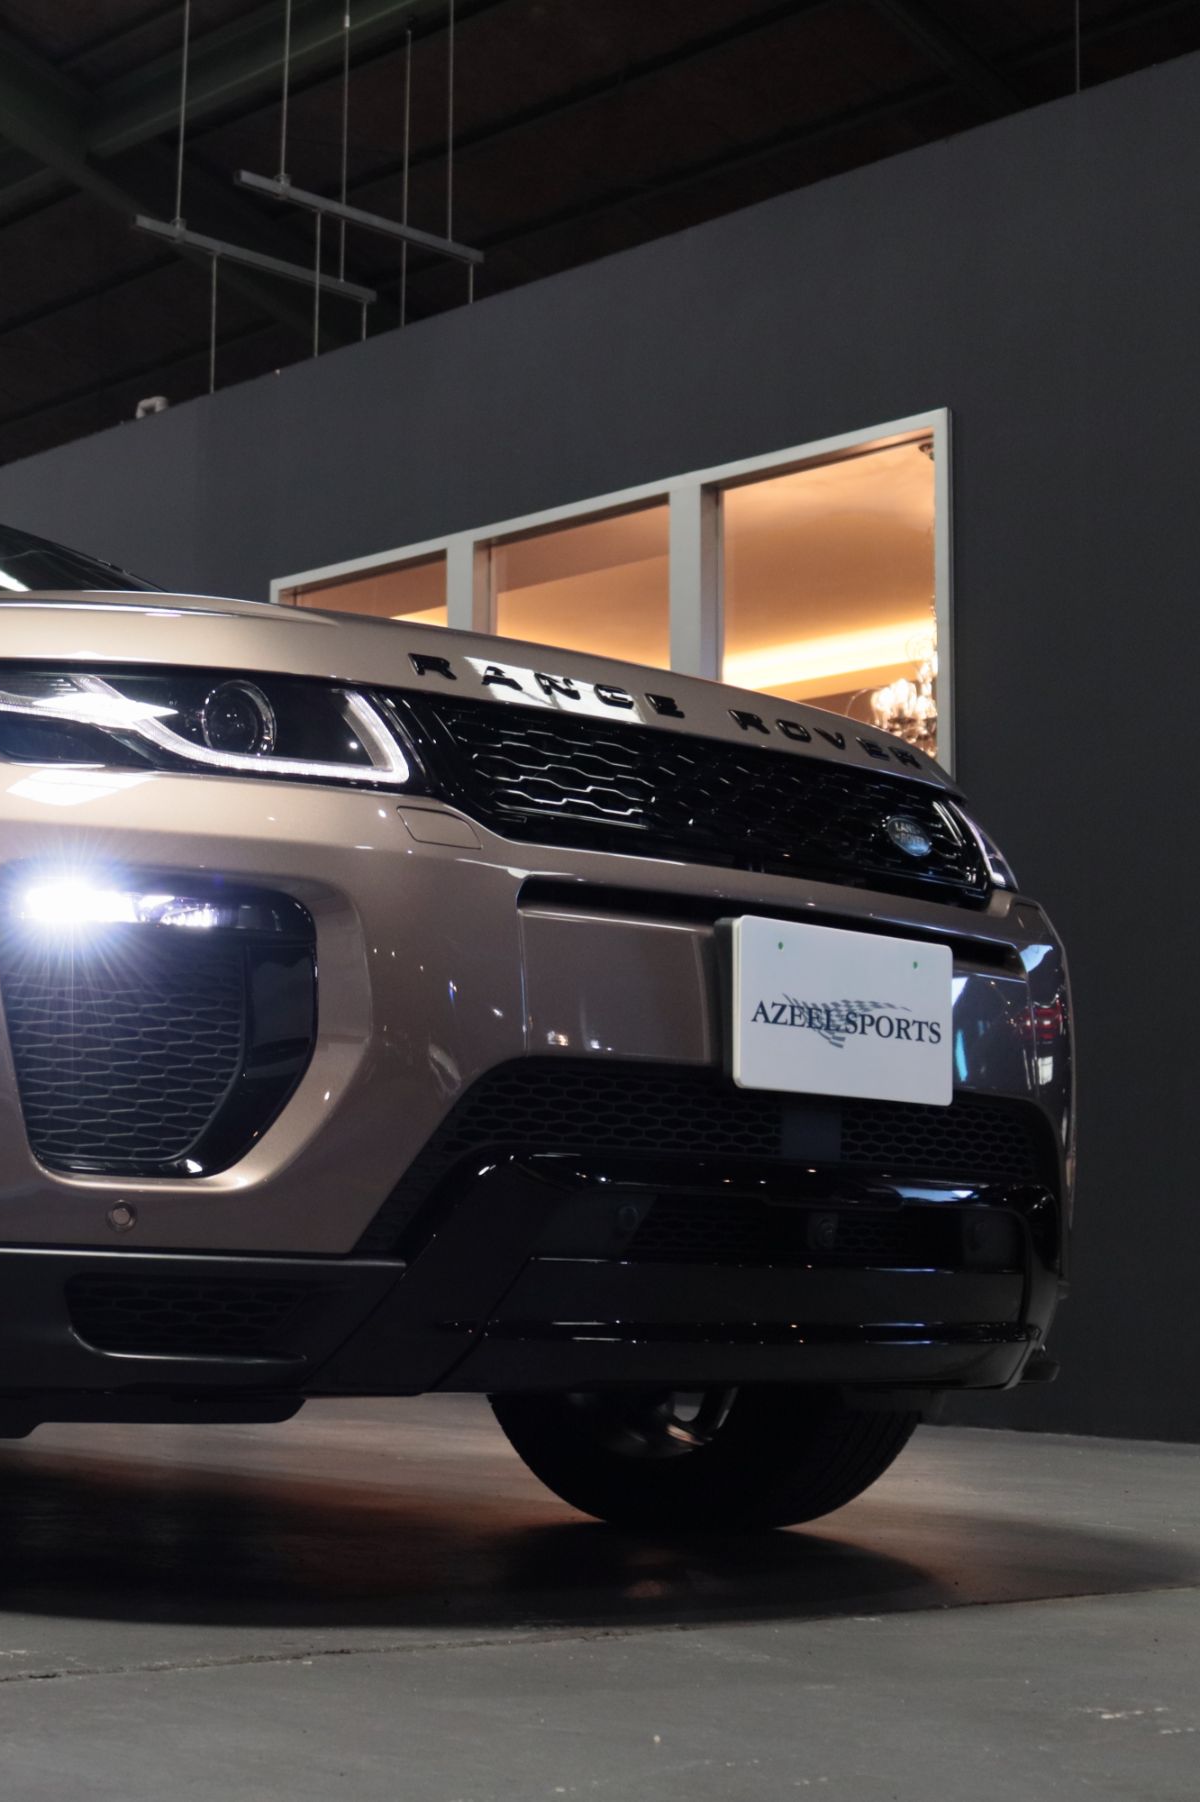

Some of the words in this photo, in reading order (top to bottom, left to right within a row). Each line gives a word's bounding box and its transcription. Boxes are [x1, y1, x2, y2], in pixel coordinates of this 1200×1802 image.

[408, 653, 685, 718] RANGE
[727, 709, 923, 770] ROVER
[845, 1010, 942, 1045] SPORTS
